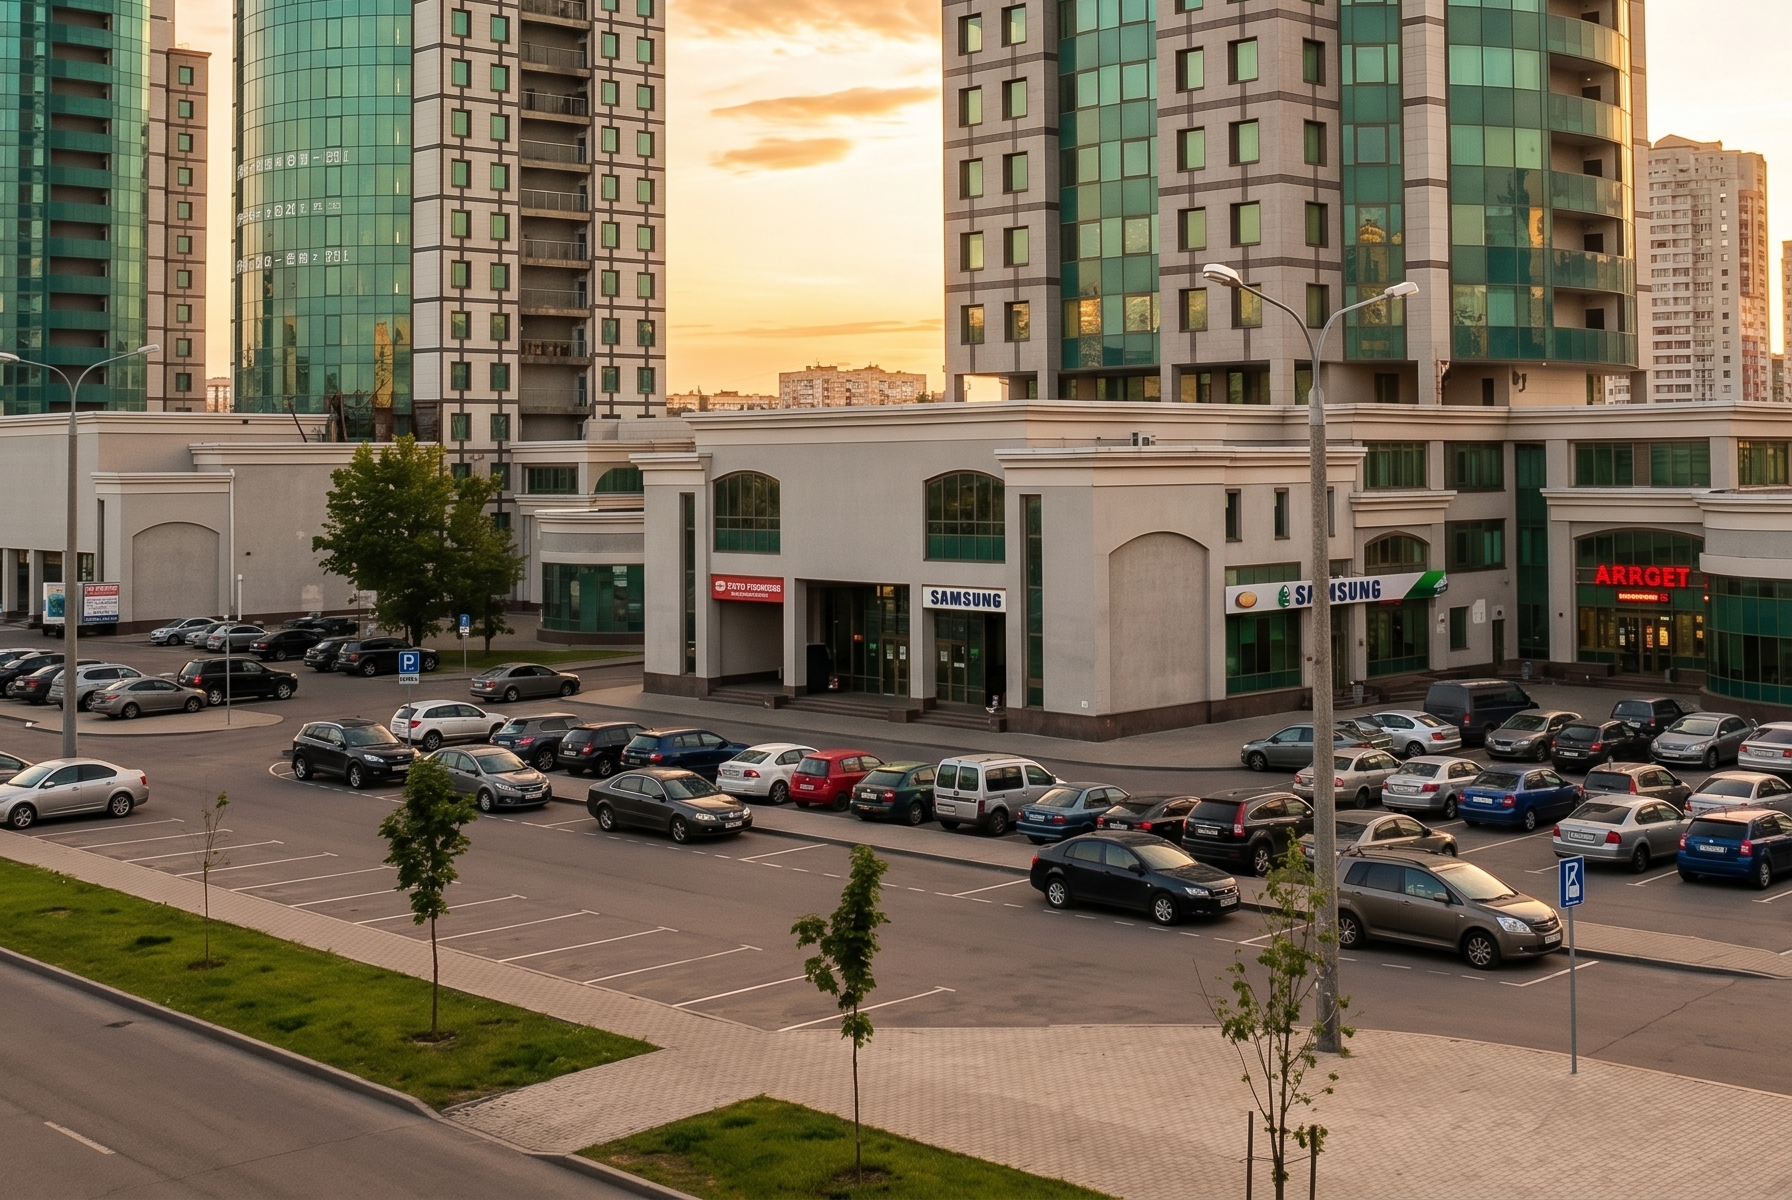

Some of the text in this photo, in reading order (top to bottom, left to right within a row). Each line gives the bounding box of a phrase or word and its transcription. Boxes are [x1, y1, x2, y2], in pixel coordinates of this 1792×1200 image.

[1594, 565, 1690, 588] ARRGET
[930, 589, 1002, 608] SAMSUNG
[403, 654, 415, 670] P
